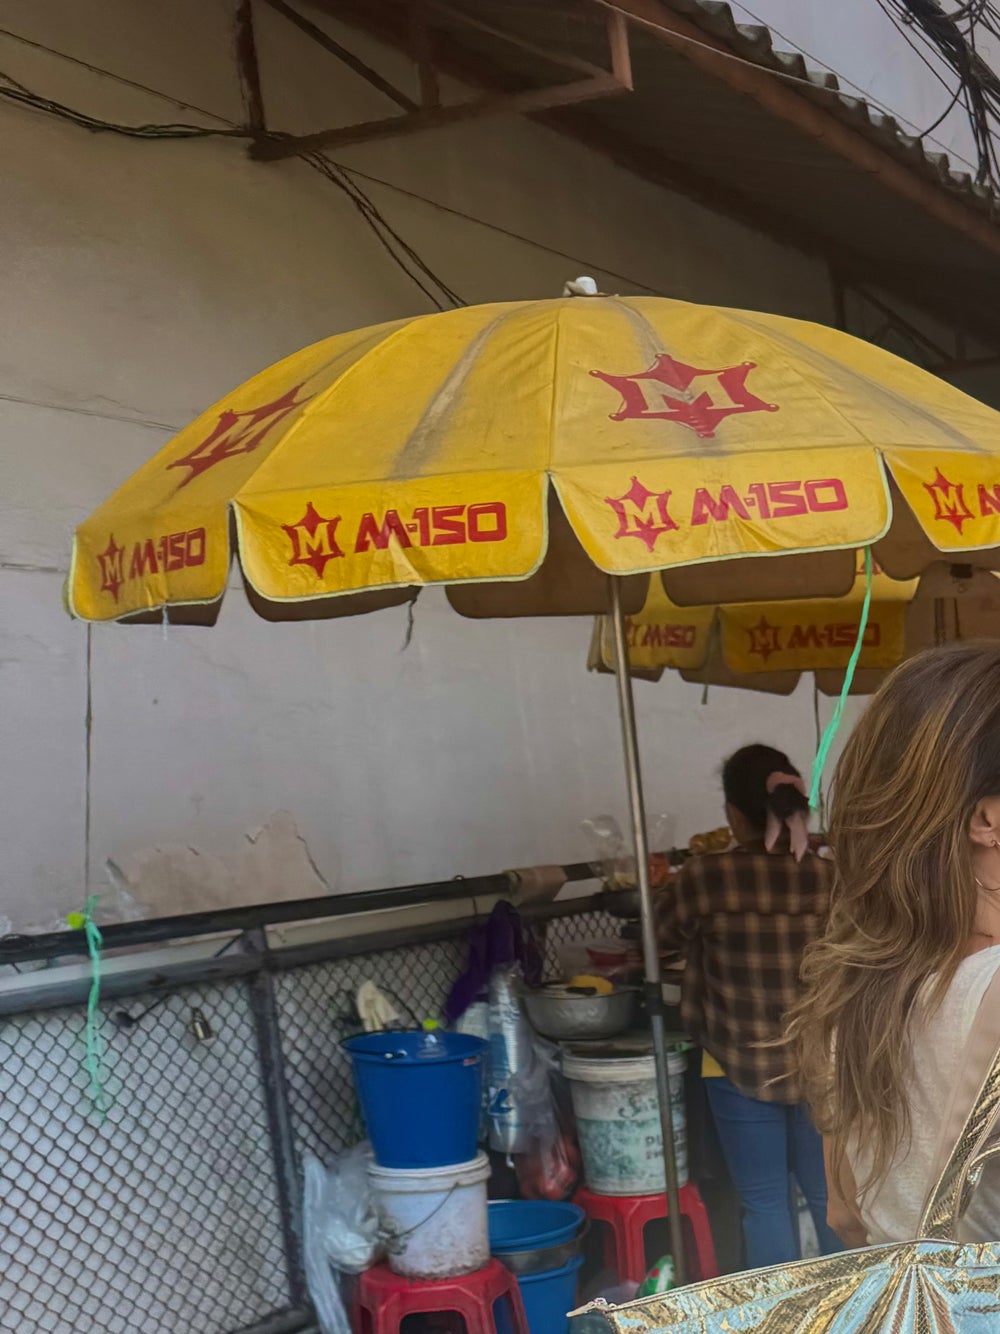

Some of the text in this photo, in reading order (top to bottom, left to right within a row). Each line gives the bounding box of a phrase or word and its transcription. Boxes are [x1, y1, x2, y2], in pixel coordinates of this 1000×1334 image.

[690, 478, 849, 526] M-150
[353, 501, 508, 554] M-150
[128, 527, 206, 580] M-150
[640, 623, 697, 648] M-150
[788, 622, 880, 648] M-150
